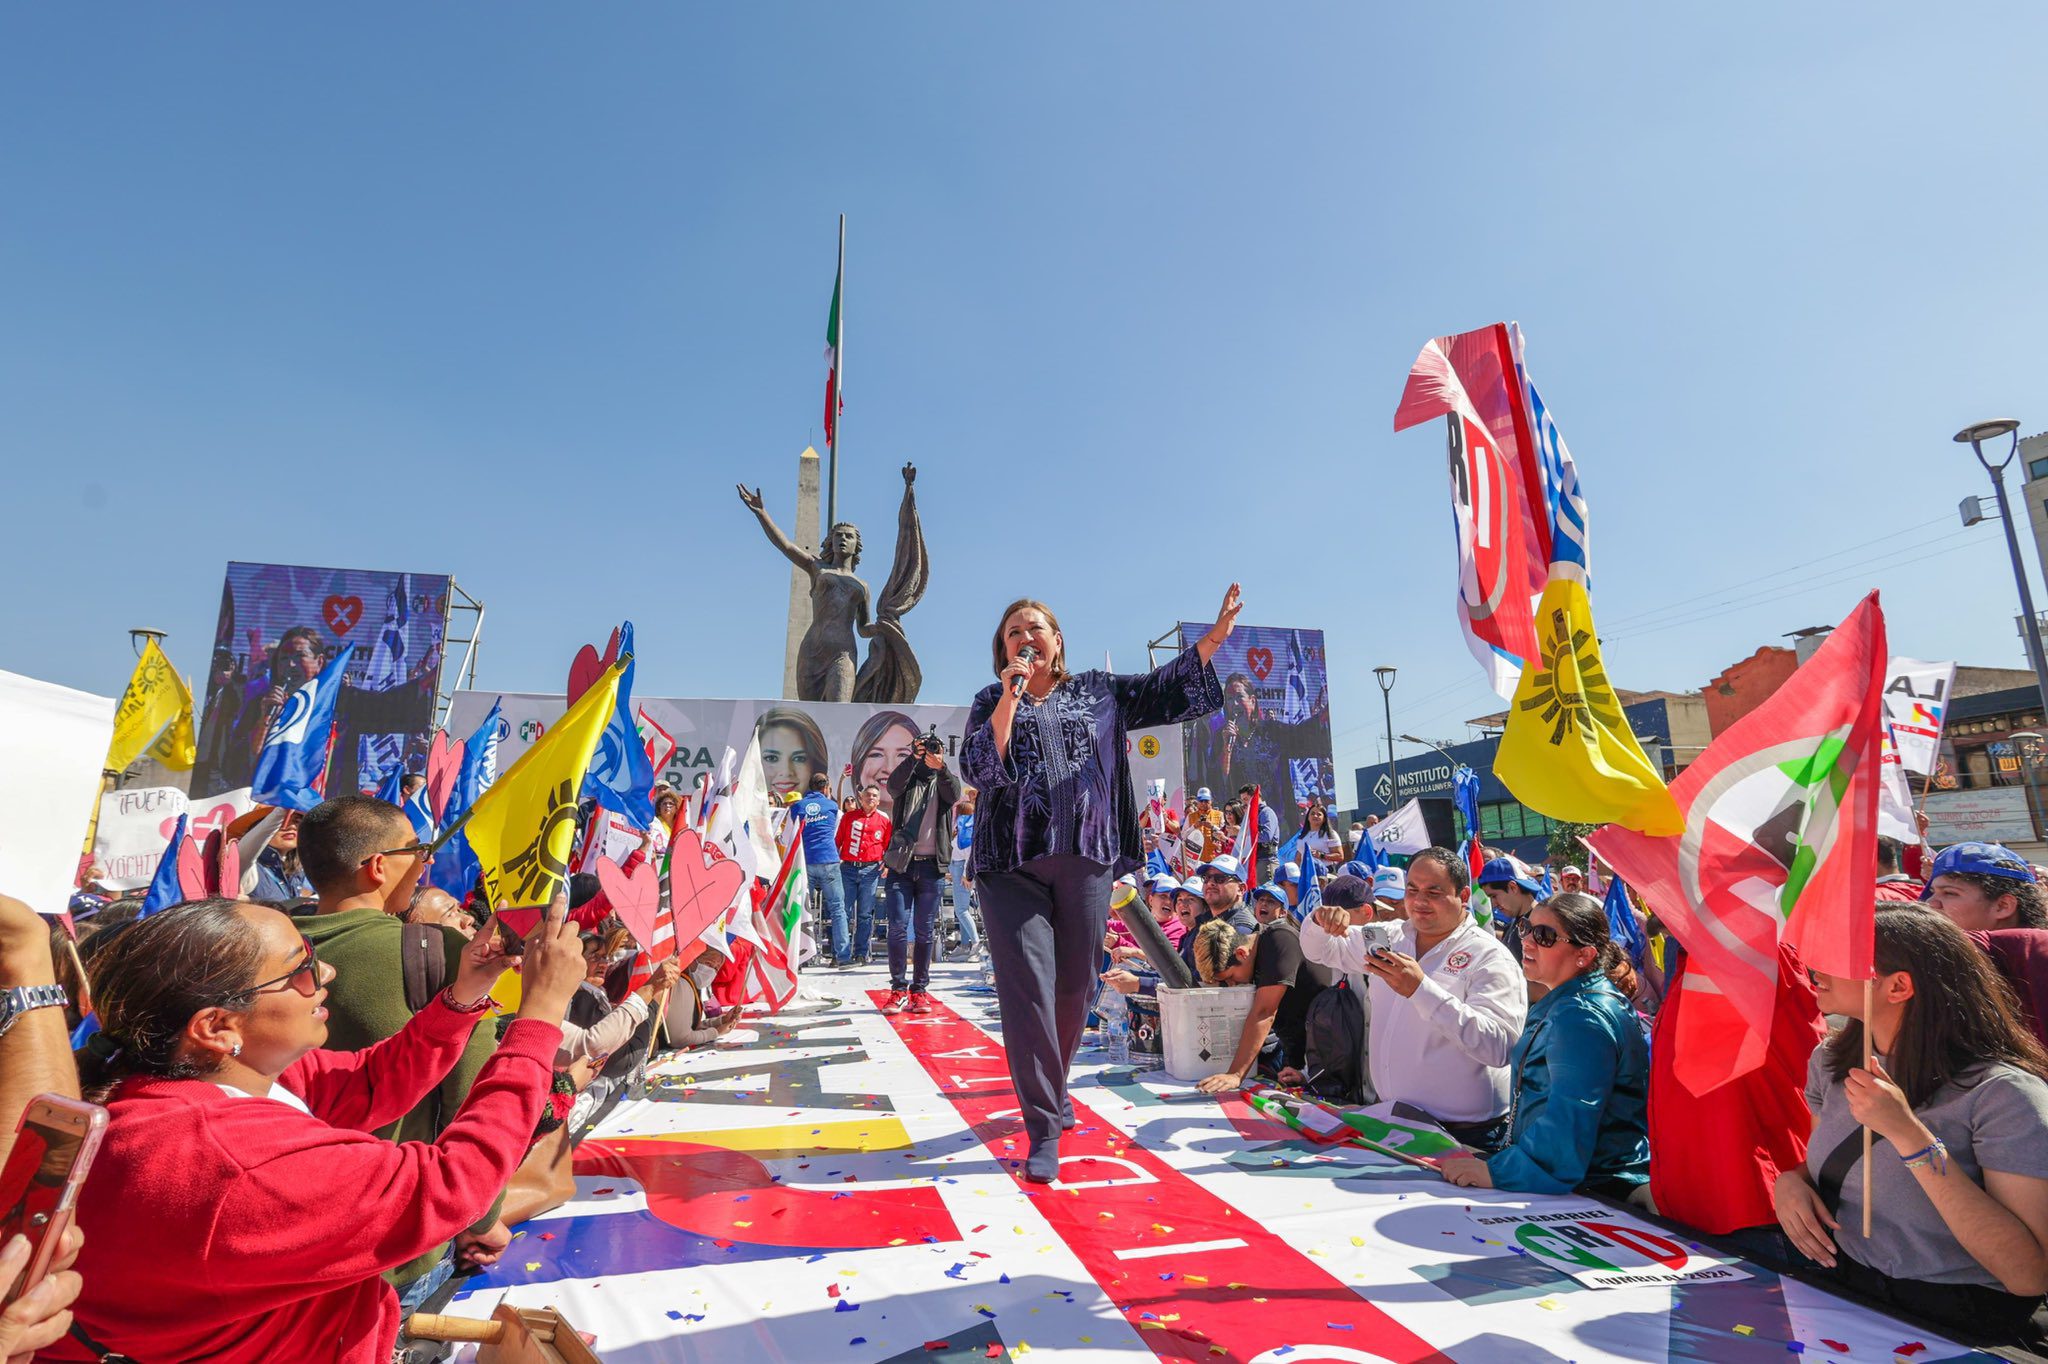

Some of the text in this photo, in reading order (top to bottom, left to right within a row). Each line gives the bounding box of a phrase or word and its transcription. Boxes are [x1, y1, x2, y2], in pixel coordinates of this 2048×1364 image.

[1397, 766, 1450, 787] INSTITUTO
[848, 820, 864, 857] ALITO
[1477, 1210, 1615, 1226] SAN GABRIEL
[1593, 1269, 1734, 1286] RUMBO AL 2024
